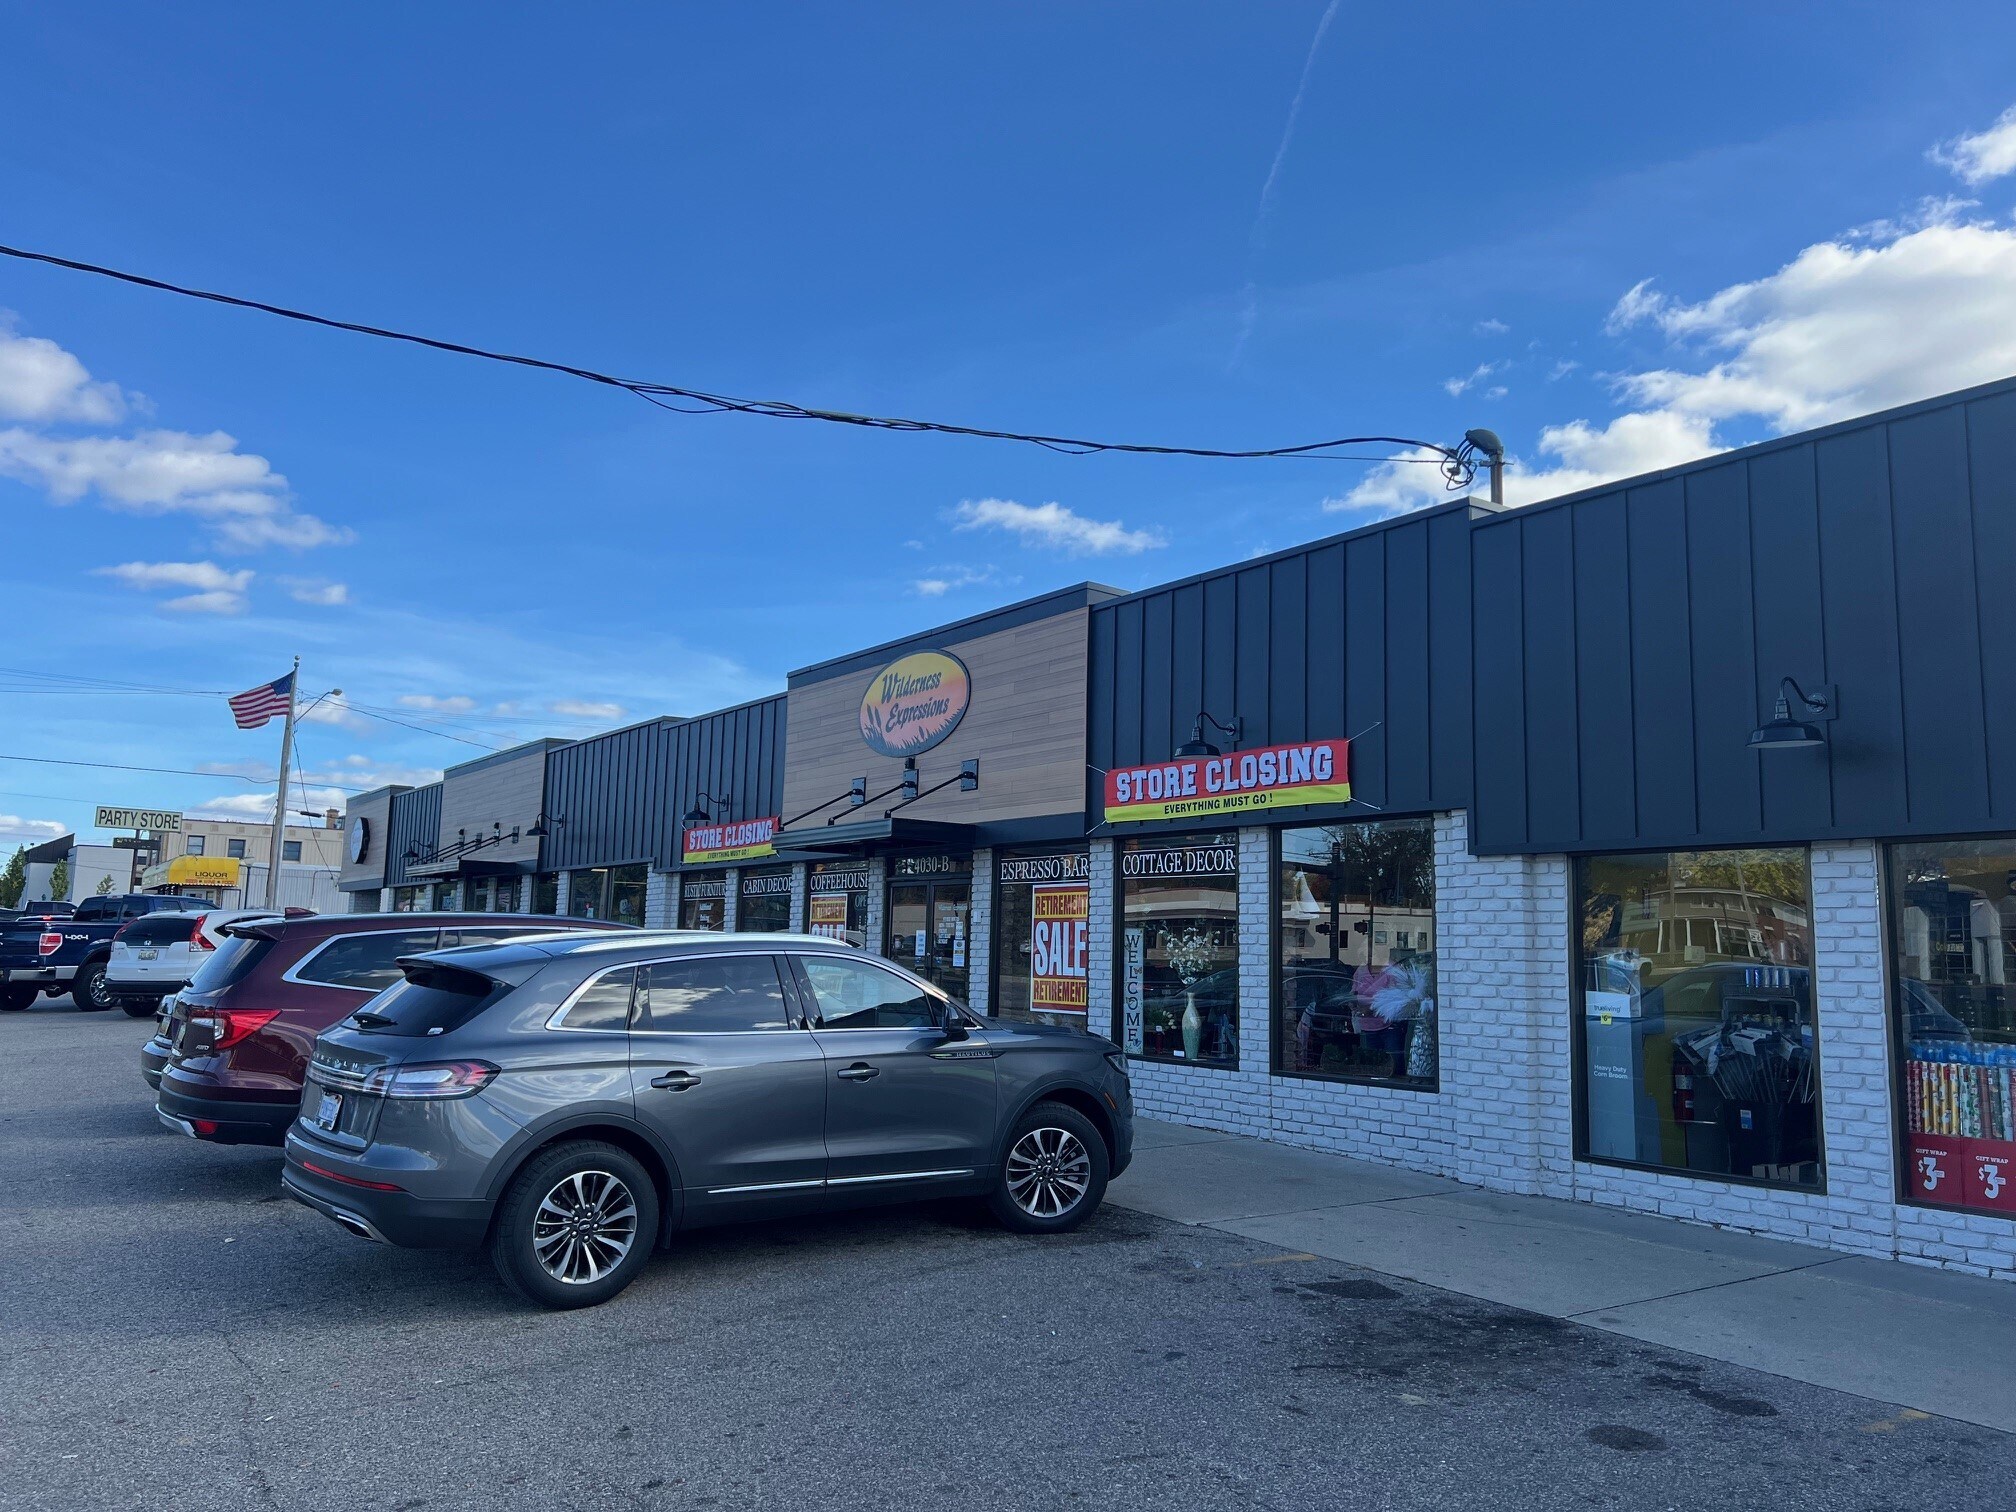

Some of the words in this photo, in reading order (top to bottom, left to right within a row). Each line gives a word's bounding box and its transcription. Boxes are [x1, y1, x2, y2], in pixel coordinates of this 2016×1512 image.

[881, 671, 942, 704] Wilderness
[885, 697, 950, 733] Expressions
[1116, 763, 1198, 803] STORE
[1205, 745, 1334, 793] CLOSING
[1164, 799, 1221, 814] EVERYTHING
[1223, 796, 1250, 808] MUST
[1252, 795, 1267, 804] GO
[98, 809, 139, 827] PARTY
[140, 812, 180, 829] STORE
[689, 827, 723, 851] STORE
[725, 819, 773, 847] CLOSING
[1000, 858, 1061, 881] ESPRESSO
[1062, 856, 1089, 878] BAR
[1122, 851, 1183, 875] COTTAGE
[1185, 849, 1236, 872] DECOR
[743, 878, 766, 894] CABIN
[1034, 893, 1088, 916] RETIREMENT
[1034, 920, 1087, 977] SALE
[1033, 981, 1087, 1003] RETIREMENT
[1125, 933, 1141, 1043] WELCOME
[1594, 1064, 1612, 1072] Heavy
[1612, 1065, 1627, 1073] Duty
